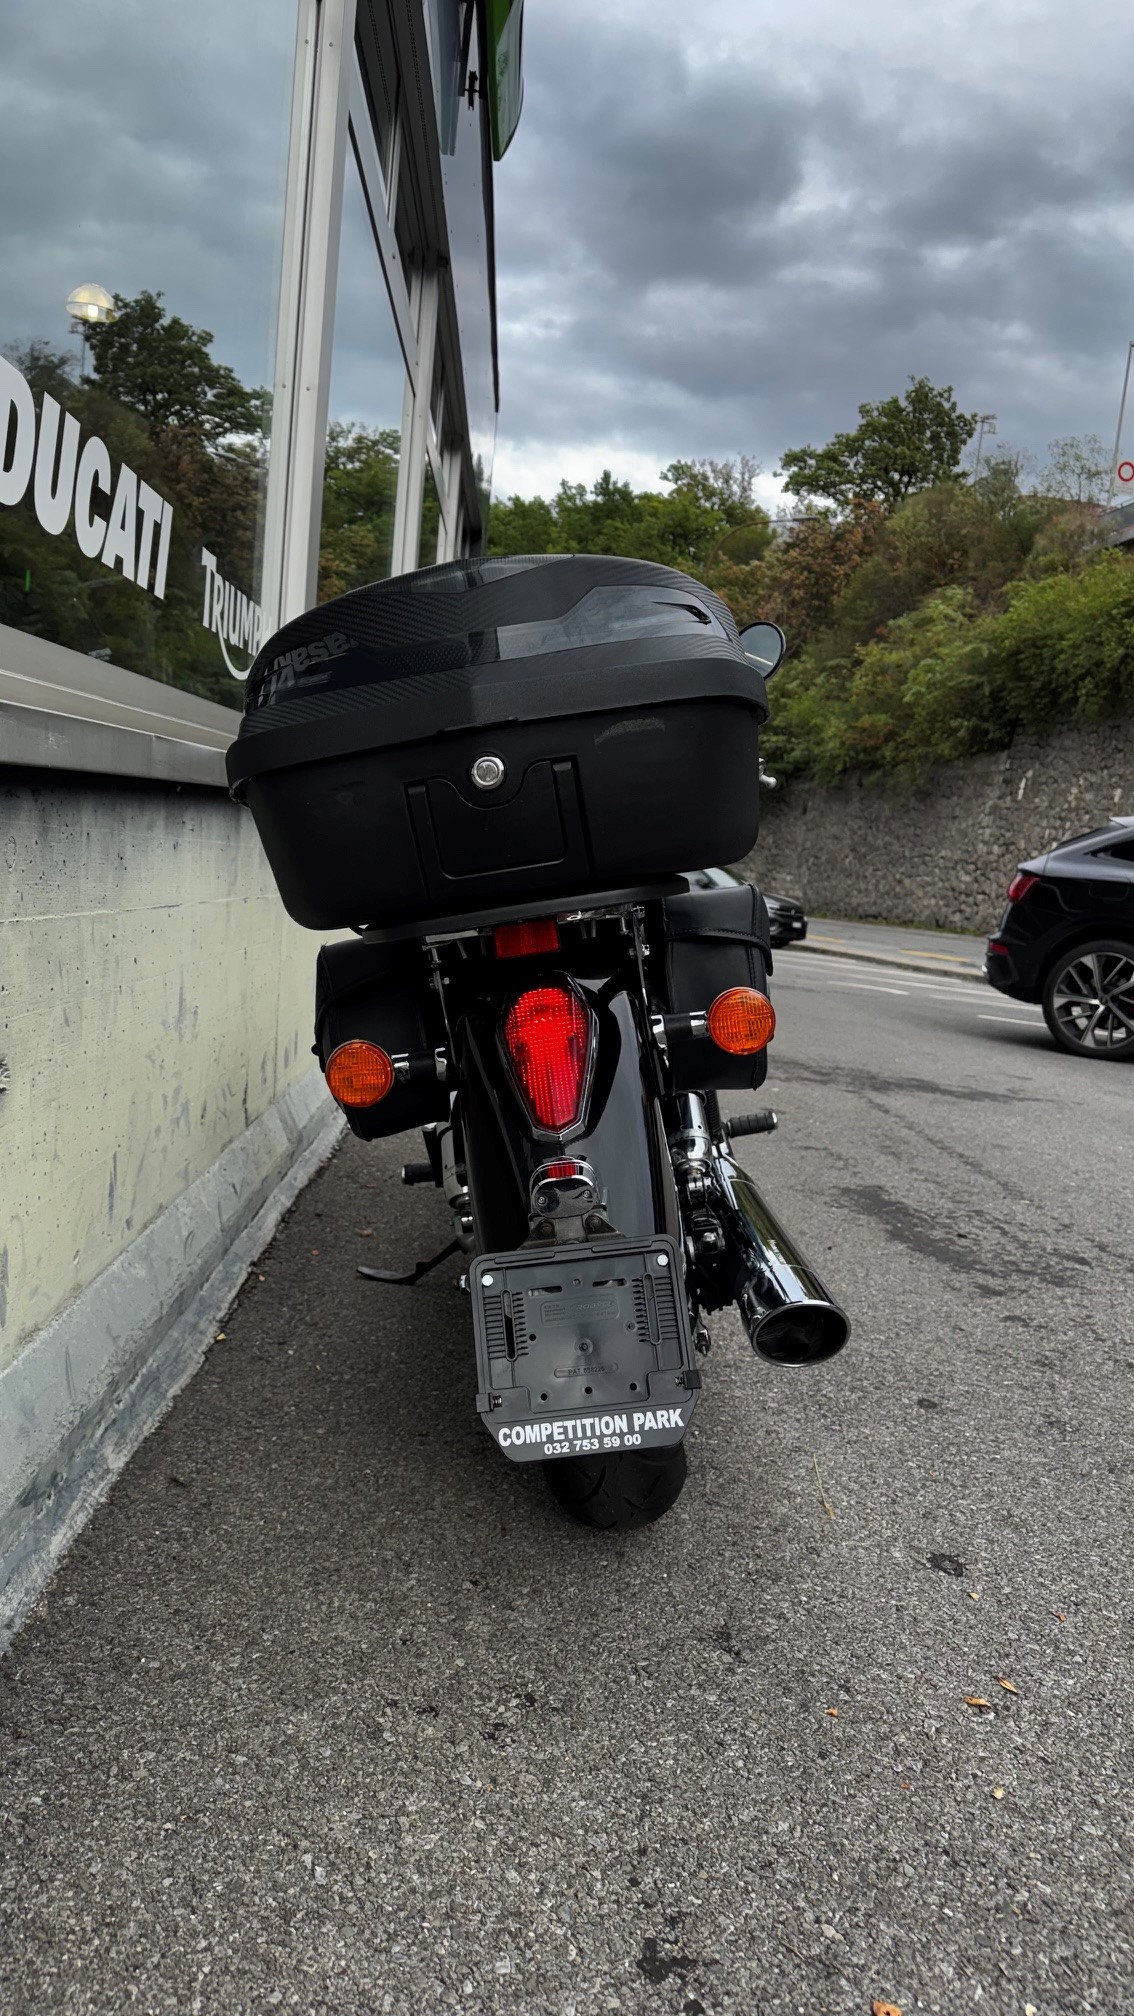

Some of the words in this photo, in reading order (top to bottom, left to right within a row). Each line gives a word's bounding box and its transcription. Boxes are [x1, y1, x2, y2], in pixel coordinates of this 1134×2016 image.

[0, 354, 174, 600] DUCATI
[498, 1414, 629, 1447] COMPETITION
[633, 1408, 685, 1431] PARK
[544, 1441, 571, 1455] 032
[573, 1438, 600, 1452] 753
[603, 1435, 621, 1448] 59
[624, 1433, 642, 1446] 00
